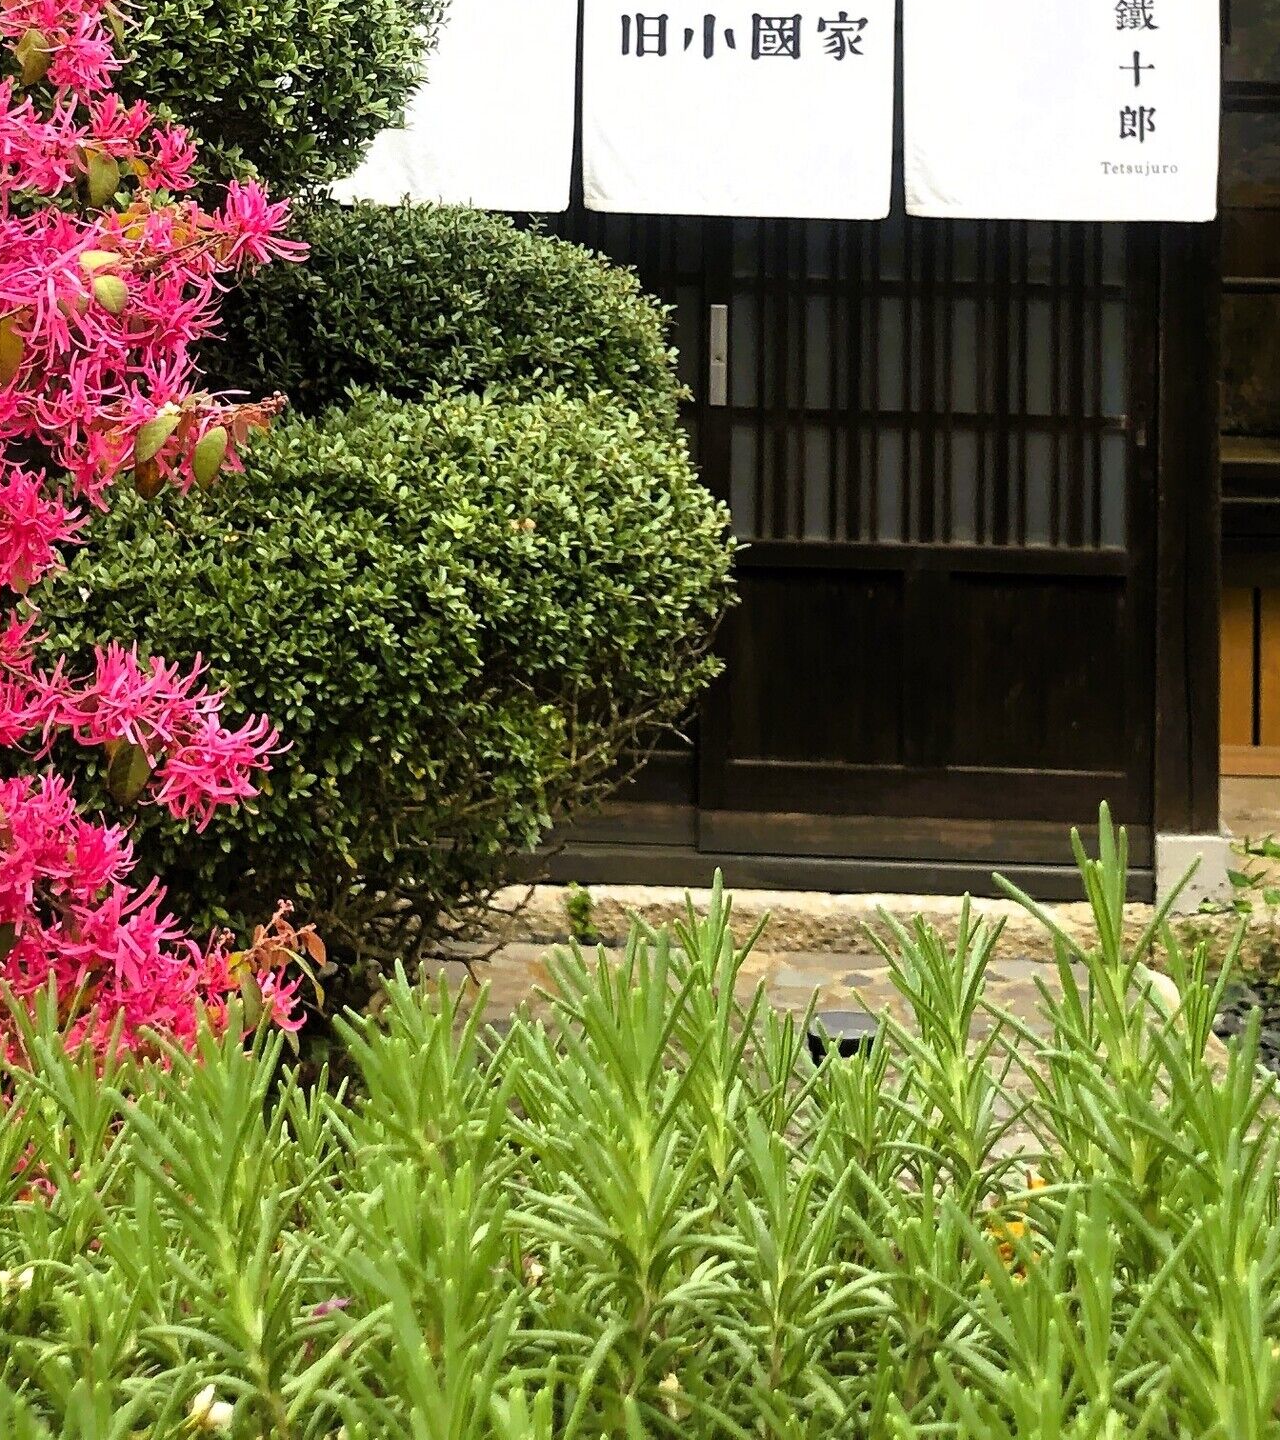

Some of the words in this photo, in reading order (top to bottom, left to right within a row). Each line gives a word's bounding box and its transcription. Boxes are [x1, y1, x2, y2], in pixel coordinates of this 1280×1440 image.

[620, 10, 869, 61] 旧小國家
[1099, 160, 1179, 176] Tetsujuro
